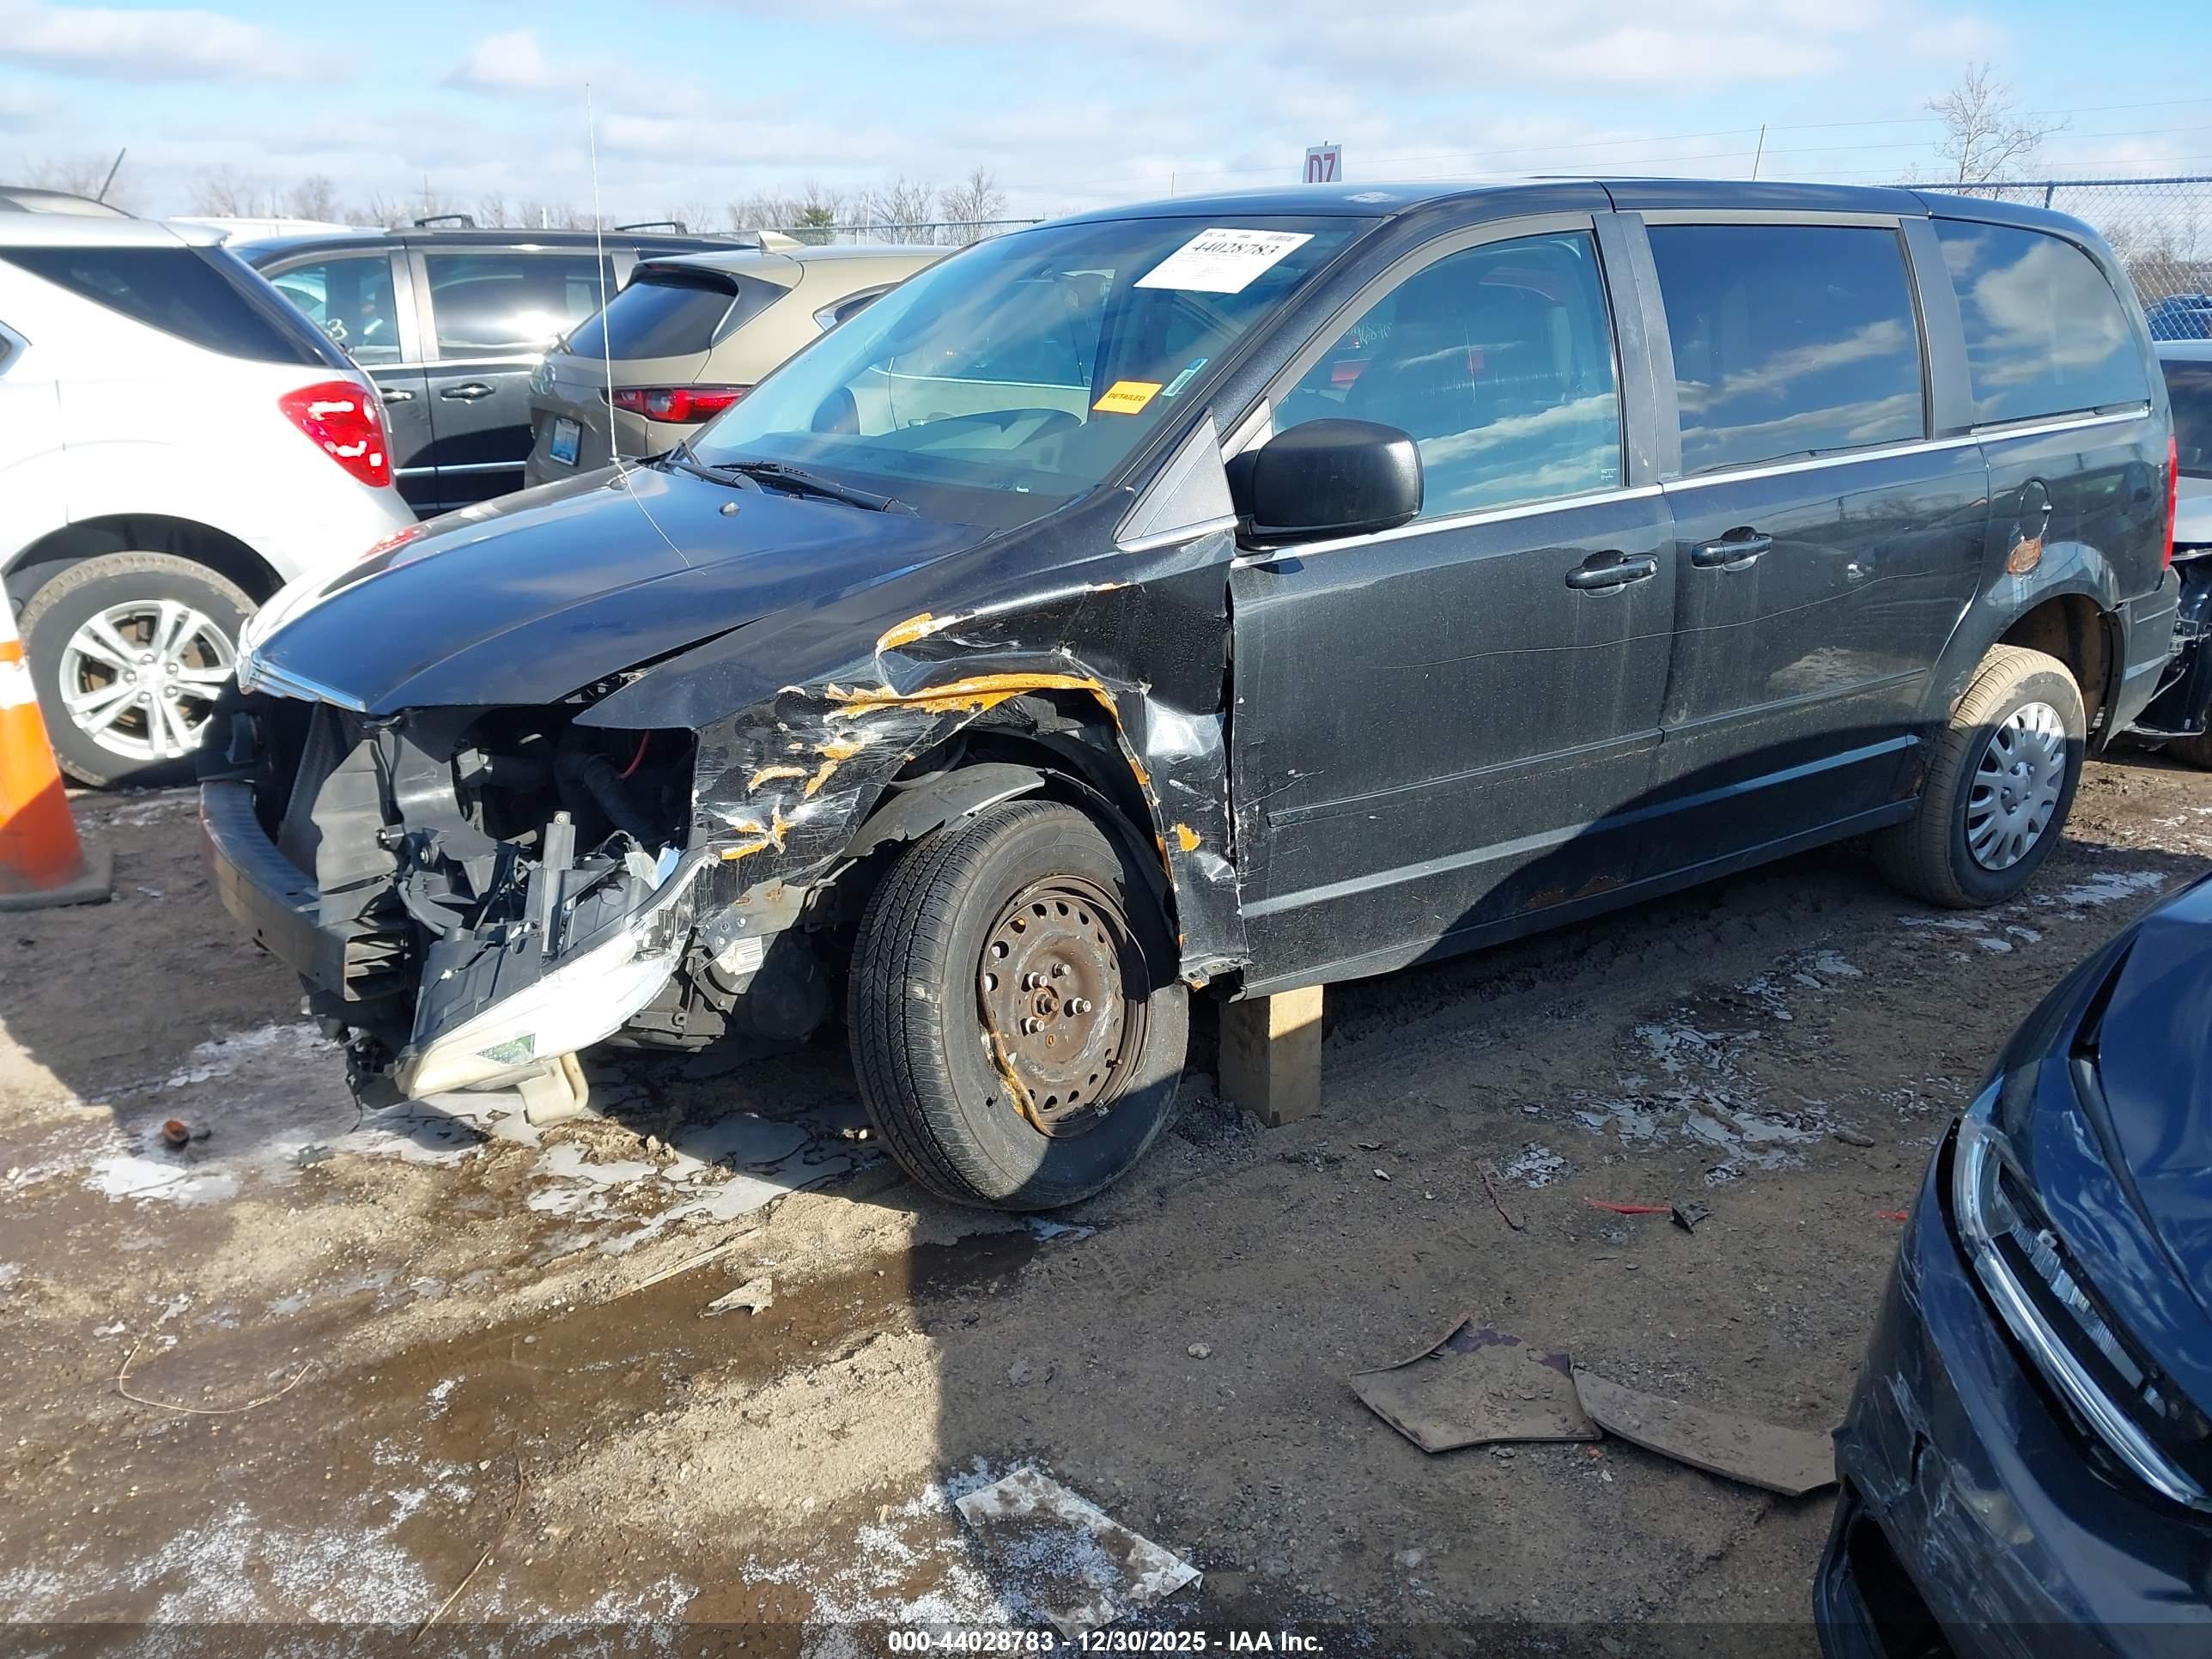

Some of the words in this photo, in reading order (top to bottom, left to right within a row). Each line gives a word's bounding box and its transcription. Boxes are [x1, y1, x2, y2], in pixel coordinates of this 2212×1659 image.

[1308, 152, 1336, 184] D7
[1192, 240, 1280, 256] 44028783
[1107, 392, 1147, 402] DETAILED
